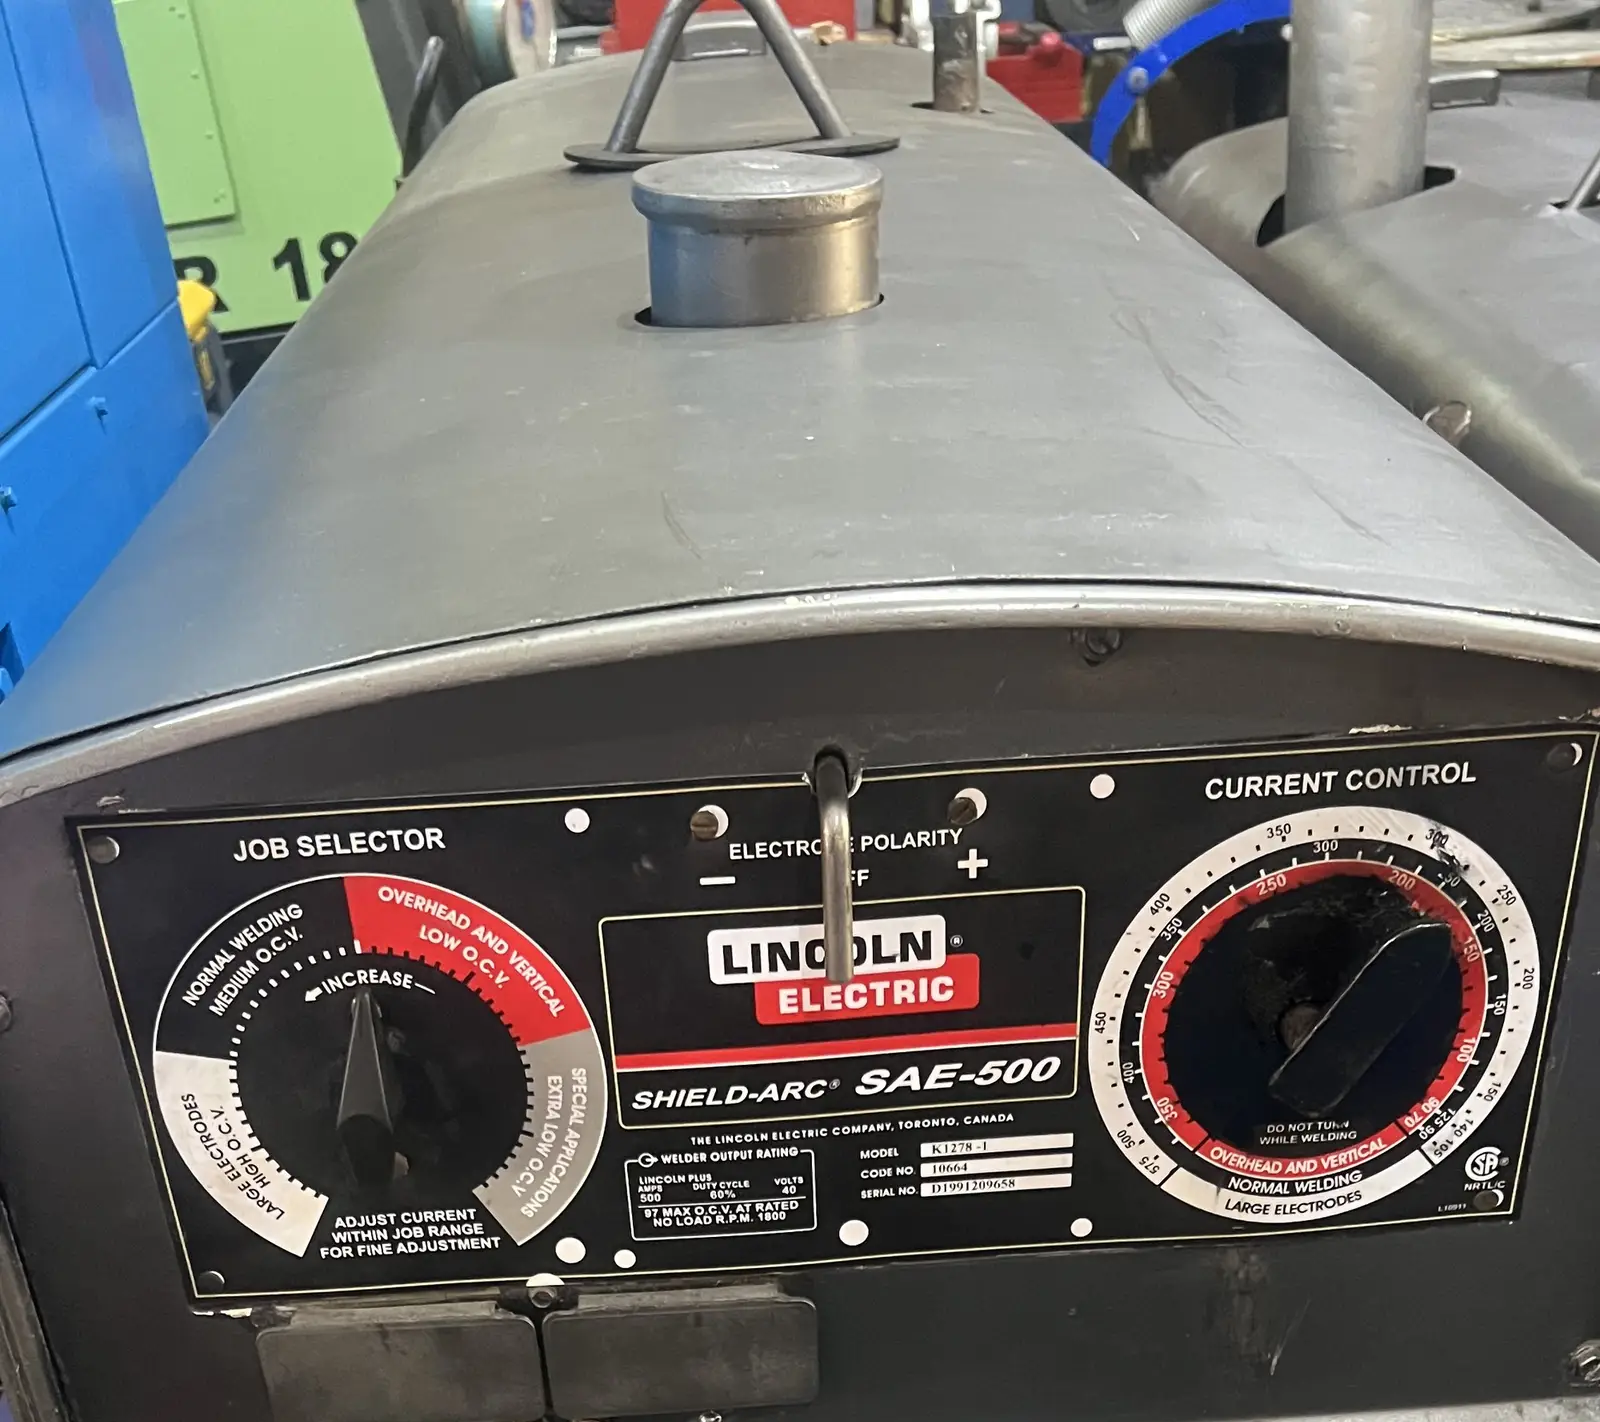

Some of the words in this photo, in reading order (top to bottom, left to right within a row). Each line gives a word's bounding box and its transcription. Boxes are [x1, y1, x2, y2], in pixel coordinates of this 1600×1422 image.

[1205, 771, 1338, 800] CURRENT
[1346, 761, 1477, 791] CONTROL
[861, 828, 963, 852] POLARITY
[1266, 823, 1292, 839] 350
[233, 837, 290, 862] JOB
[298, 827, 446, 858] SELECTOR
[1313, 840, 1339, 853] 300
[1256, 873, 1287, 896] 250
[1388, 870, 1416, 891] 200
[1149, 892, 1171, 916] 400
[1497, 884, 1517, 907] 250
[1160, 917, 1183, 941] 350
[1477, 909, 1495, 933] 200
[182, 949, 236, 1007] NORMAL
[229, 904, 303, 951] WELDING
[378, 886, 471, 930] OVERHEAD
[471, 925, 509, 955] AND
[508, 950, 565, 1017] VERTICAL
[419, 924, 462, 951] LOW
[462, 946, 510, 988] O.C.V.
[722, 931, 933, 975] LINCOLN
[1463, 938, 1480, 962] 150
[209, 960, 260, 1016] MEDIUM
[256, 926, 303, 963] O.C.V.
[321, 969, 413, 995] INCREASE
[1522, 967, 1534, 990] 200
[779, 976, 954, 1015] ELECTRIC
[1152, 971, 1174, 999] 300
[1493, 993, 1507, 1015] 150
[1094, 1012, 1107, 1034] 450
[1456, 1037, 1476, 1063] 100
[854, 1057, 1061, 1097] SAE-500
[1122, 1062, 1135, 1084] 400
[545, 1075, 562, 1120] EXTRA
[569, 1068, 587, 1126] SPECIAL
[1484, 1082, 1502, 1102] 150
[1156, 1096, 1178, 1121] 350
[1434, 1108, 1456, 1127] 125
[181, 1093, 242, 1182] ELECTRODES
[210, 1106, 241, 1150] O.C.V.
[536, 1123, 558, 1157] LOW
[691, 1136, 712, 1146] THE
[715, 1132, 768, 1145] LINCOLN
[772, 1128, 828, 1141] ELECTRIC
[832, 1122, 895, 1136] COMPANY,
[898, 1118, 960, 1130] TORONTO,
[964, 1113, 1014, 1125] CANADA
[1116, 1129, 1136, 1148] 500
[1259, 1135, 1298, 1145] WHILE
[1301, 1131, 1357, 1143] WELDING
[1267, 1124, 1285, 1134] DO
[1288, 1122, 1313, 1132] NOT
[1454, 1119, 1474, 1138] 140
[661, 1152, 707, 1165] WELDER
[710, 1149, 753, 1162] OUTPUT
[756, 1147, 799, 1159] RATING
[860, 1148, 899, 1159] MODEL
[1210, 1147, 1283, 1174] OVERHEAD
[1285, 1159, 1318, 1174] AND
[1320, 1138, 1388, 1170] VERTICAL
[237, 1153, 271, 1188] HIGH
[520, 1128, 581, 1218] APPLICATIONS
[639, 1175, 686, 1185] LINCOLN
[688, 1173, 712, 1183] PLUS
[860, 1168, 893, 1179] CODE
[932, 1163, 968, 1174] 10664
[1228, 1176, 1290, 1195] NORMAL
[1295, 1170, 1363, 1193] WELDING
[638, 1185, 663, 1194] AMPS
[693, 1182, 718, 1191] DUTY
[719, 1180, 750, 1189] CYCLE
[774, 1176, 804, 1186] VOLTS
[640, 1193, 661, 1203] 500
[709, 1190, 736, 1199] 60%
[782, 1185, 797, 1195] 40
[860, 1188, 895, 1199] SERIAL
[898, 1186, 919, 1195] NO.
[932, 1179, 1015, 1194] D1991209658
[238, 1181, 285, 1220] LARGE
[644, 1209, 658, 1218] 97
[662, 1206, 691, 1217] MAX
[694, 1204, 732, 1216] O.C.V.
[736, 1203, 752, 1214] AT
[755, 1200, 799, 1212] RATED
[1225, 1198, 1270, 1215] LARGE
[1274, 1191, 1363, 1215] ELECTRODES
[335, 1213, 396, 1229] ADJUST
[401, 1208, 477, 1224] CURRENT
[653, 1217, 673, 1228] NO
[676, 1215, 712, 1227] LOAD
[715, 1213, 753, 1224] R.P.M.
[758, 1211, 786, 1221] 1800
[332, 1228, 388, 1243] WITHIN
[392, 1226, 425, 1240] JOB
[428, 1223, 484, 1237] RANGE
[320, 1246, 354, 1259] FOR
[357, 1243, 394, 1257] FINE
[397, 1237, 501, 1254] ADJUSTMENT
